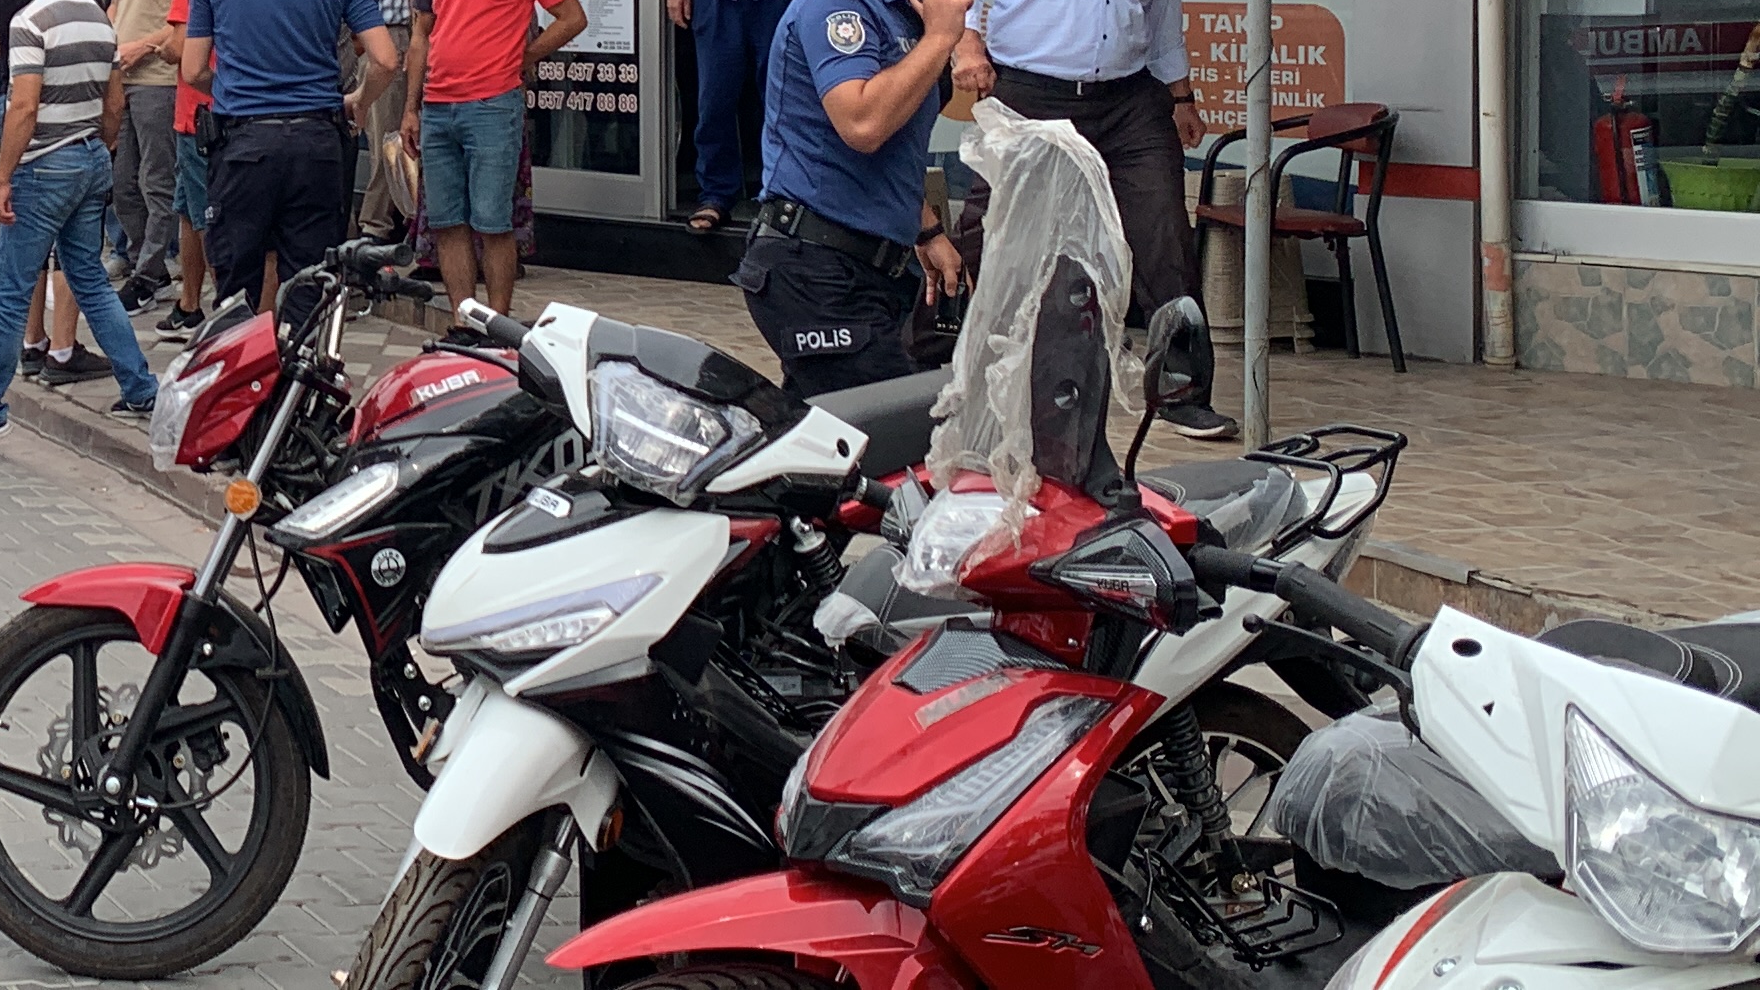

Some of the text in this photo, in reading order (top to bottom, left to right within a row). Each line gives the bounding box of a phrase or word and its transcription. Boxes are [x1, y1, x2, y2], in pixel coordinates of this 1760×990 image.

[1200, 12, 1284, 34] TAKP
[538, 61, 639, 83] 535 437 33 33
[537, 90, 565, 110] 537
[566, 91, 595, 111] 417
[596, 92, 616, 112] 88
[618, 93, 638, 113] 88
[415, 369, 481, 402] KUBA
[1096, 578, 1130, 593] KUBA
